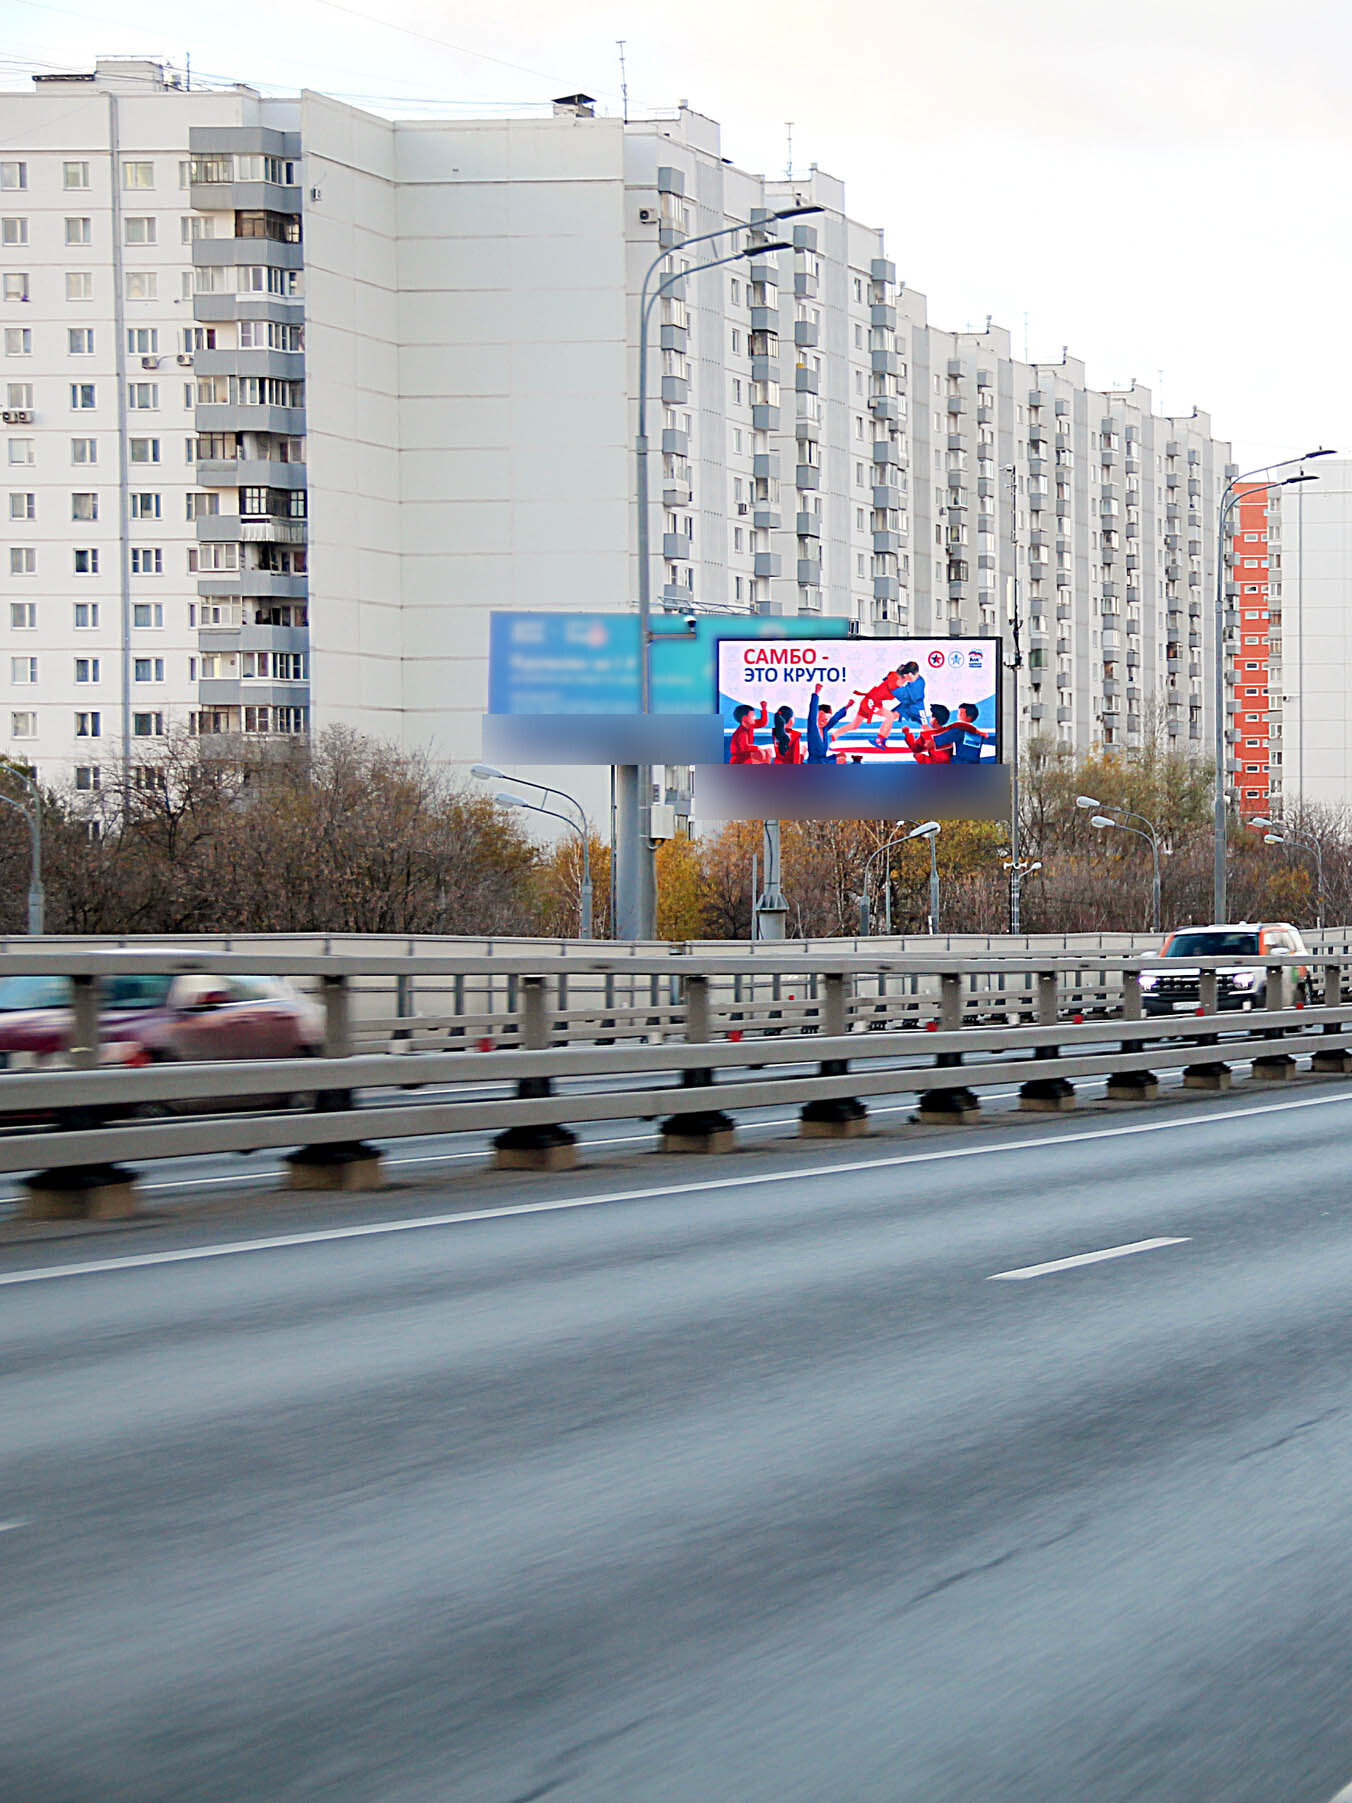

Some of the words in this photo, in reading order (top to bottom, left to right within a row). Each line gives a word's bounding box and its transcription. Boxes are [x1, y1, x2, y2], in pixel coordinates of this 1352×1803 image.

[744, 648, 816, 664] САМБО
[744, 667, 778, 682] ЭТО
[783, 667, 846, 682] КРУТО!
